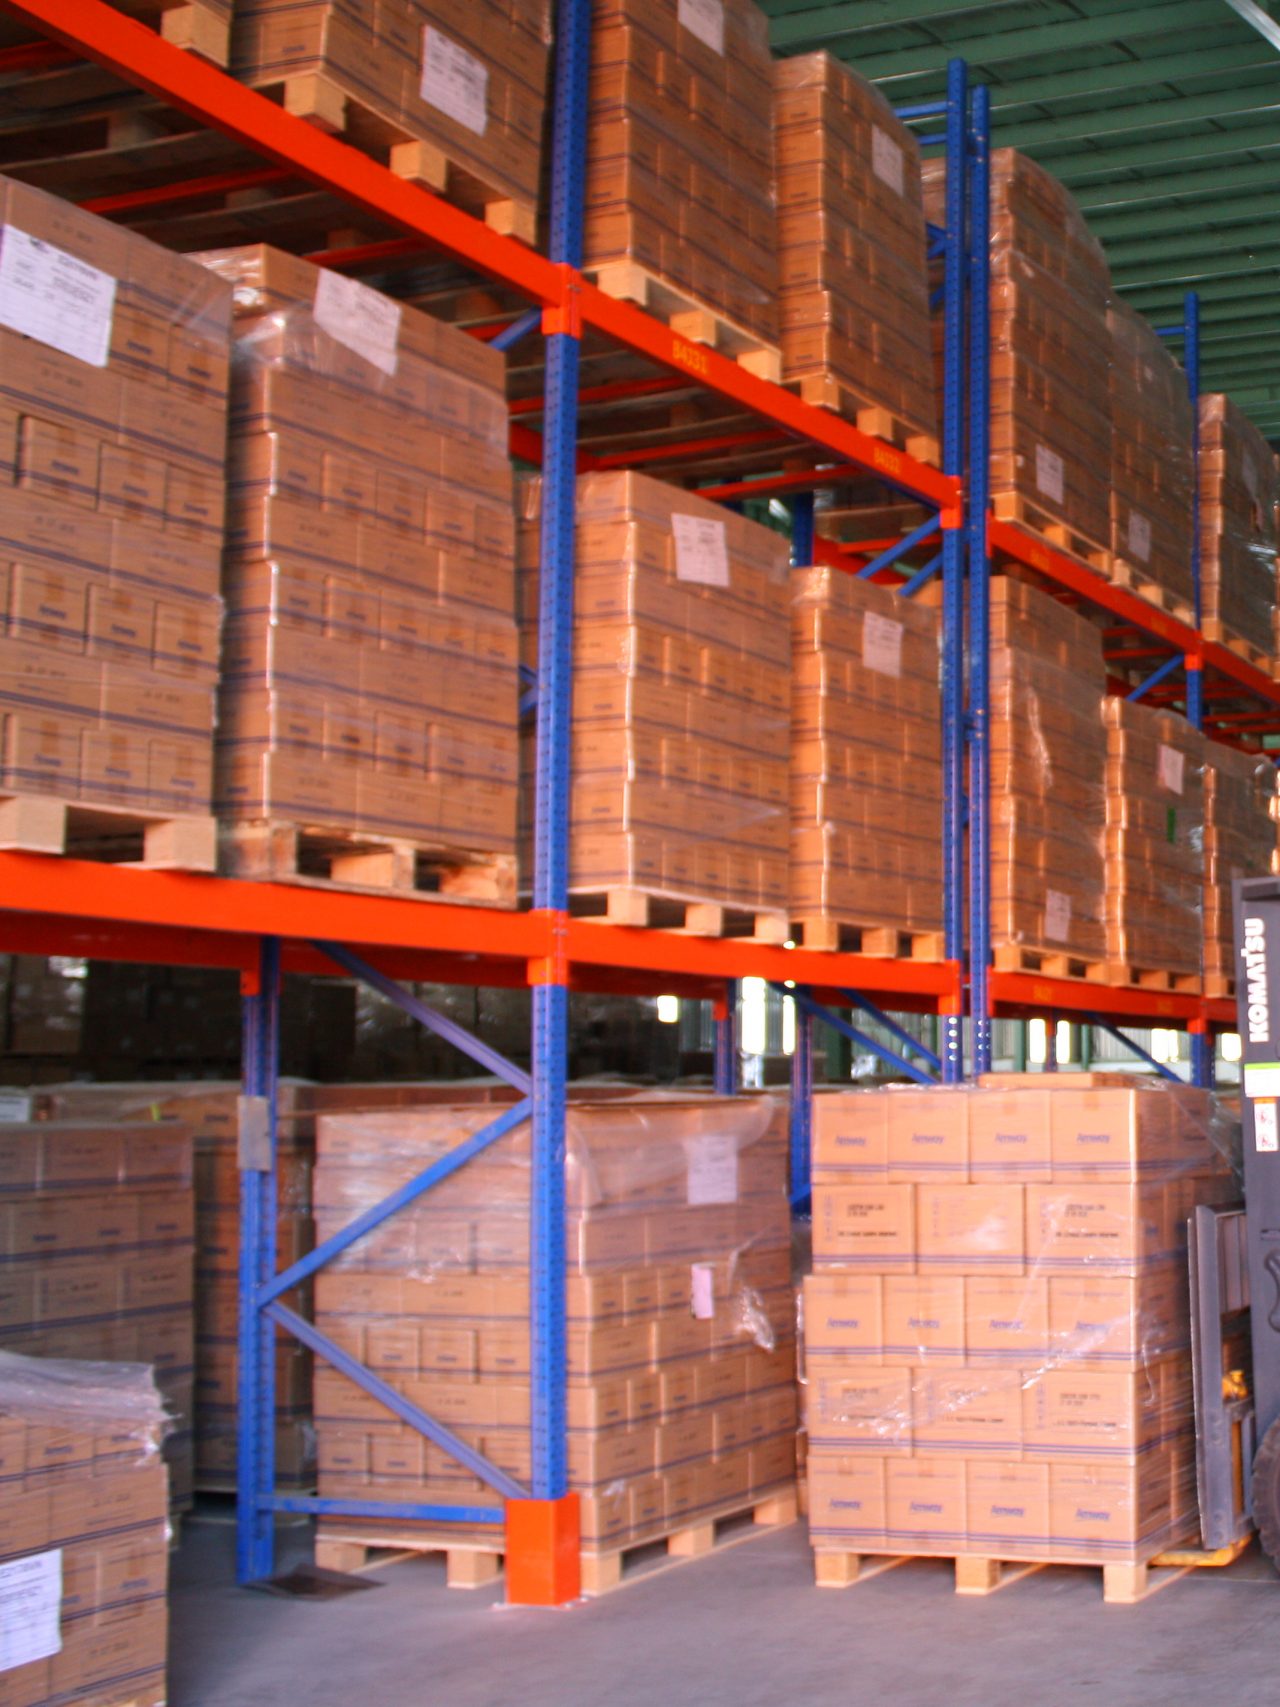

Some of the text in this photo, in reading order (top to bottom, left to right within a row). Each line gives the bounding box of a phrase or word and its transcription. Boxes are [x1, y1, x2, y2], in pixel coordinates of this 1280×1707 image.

[1241, 918, 1269, 1042] KOMATSU
[912, 1132, 945, 1145] Amway
[995, 1132, 1028, 1144] Amway
[1076, 1132, 1111, 1144] Amway
[826, 1316, 859, 1329] Amway
[830, 1498, 861, 1510] Amway
[910, 1502, 943, 1514] Amway
[991, 1505, 1024, 1517] Amway
[1075, 1508, 1111, 1521] Amway
